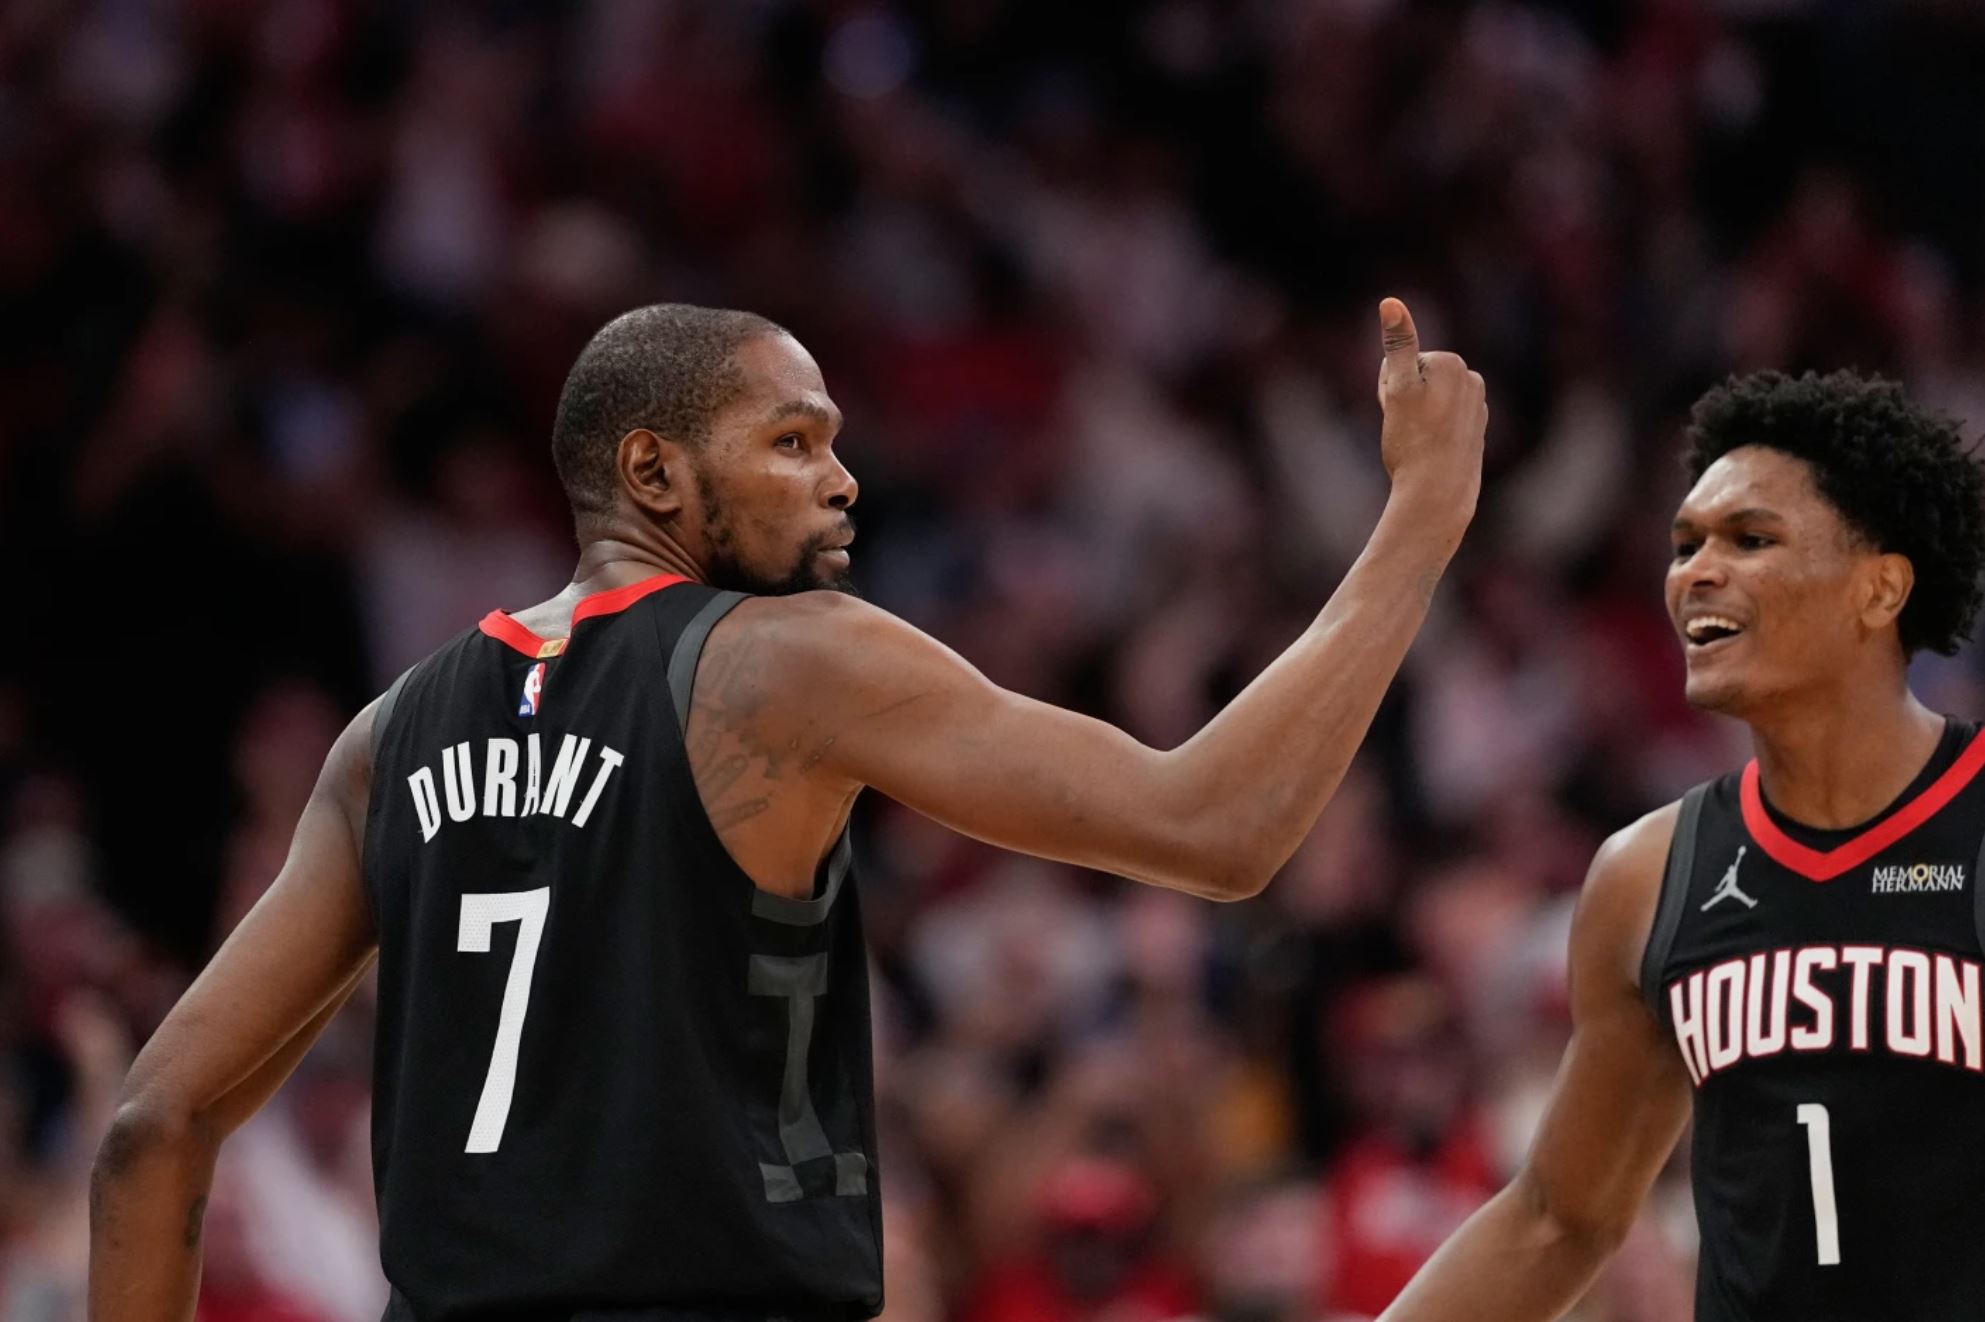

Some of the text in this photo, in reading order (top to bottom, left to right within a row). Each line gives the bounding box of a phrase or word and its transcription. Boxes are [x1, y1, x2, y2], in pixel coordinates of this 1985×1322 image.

[408, 732, 624, 844] DURANT
[1872, 878, 1965, 893] HERMANN
[1873, 864, 1965, 881] MEMORIAL
[457, 886, 550, 1154] 7
[1669, 945, 1983, 1087] HOUSTON
[1797, 1103, 1840, 1266] 1
